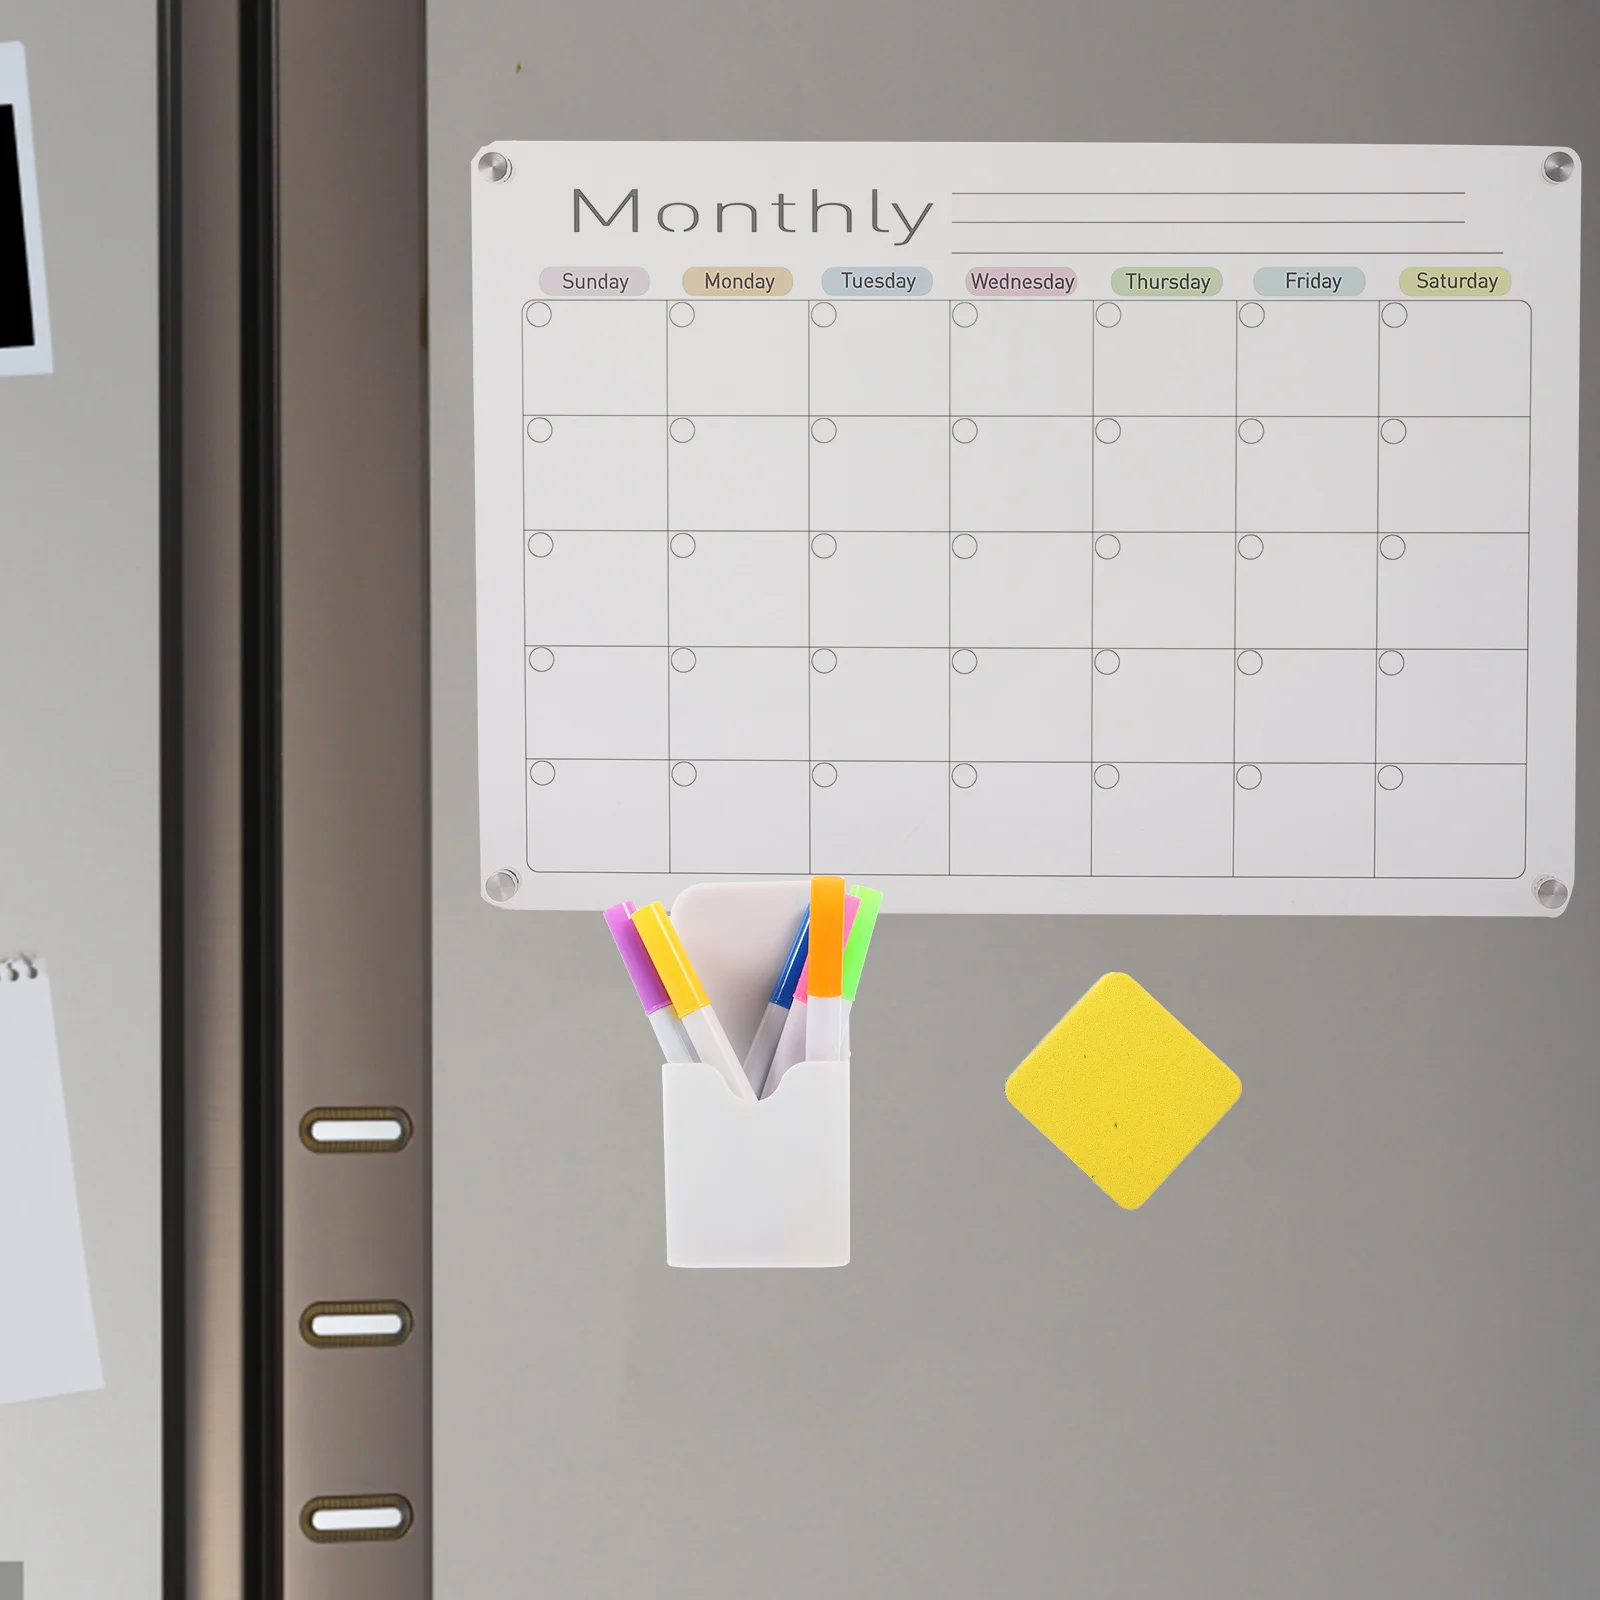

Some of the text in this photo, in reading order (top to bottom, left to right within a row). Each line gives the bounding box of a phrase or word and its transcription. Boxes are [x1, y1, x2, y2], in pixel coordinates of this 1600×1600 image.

[573, 188, 934, 246] Monthly
[562, 271, 1499, 294] Sunday Monday Tuesday Wednesday Thursday Friday Saturday
